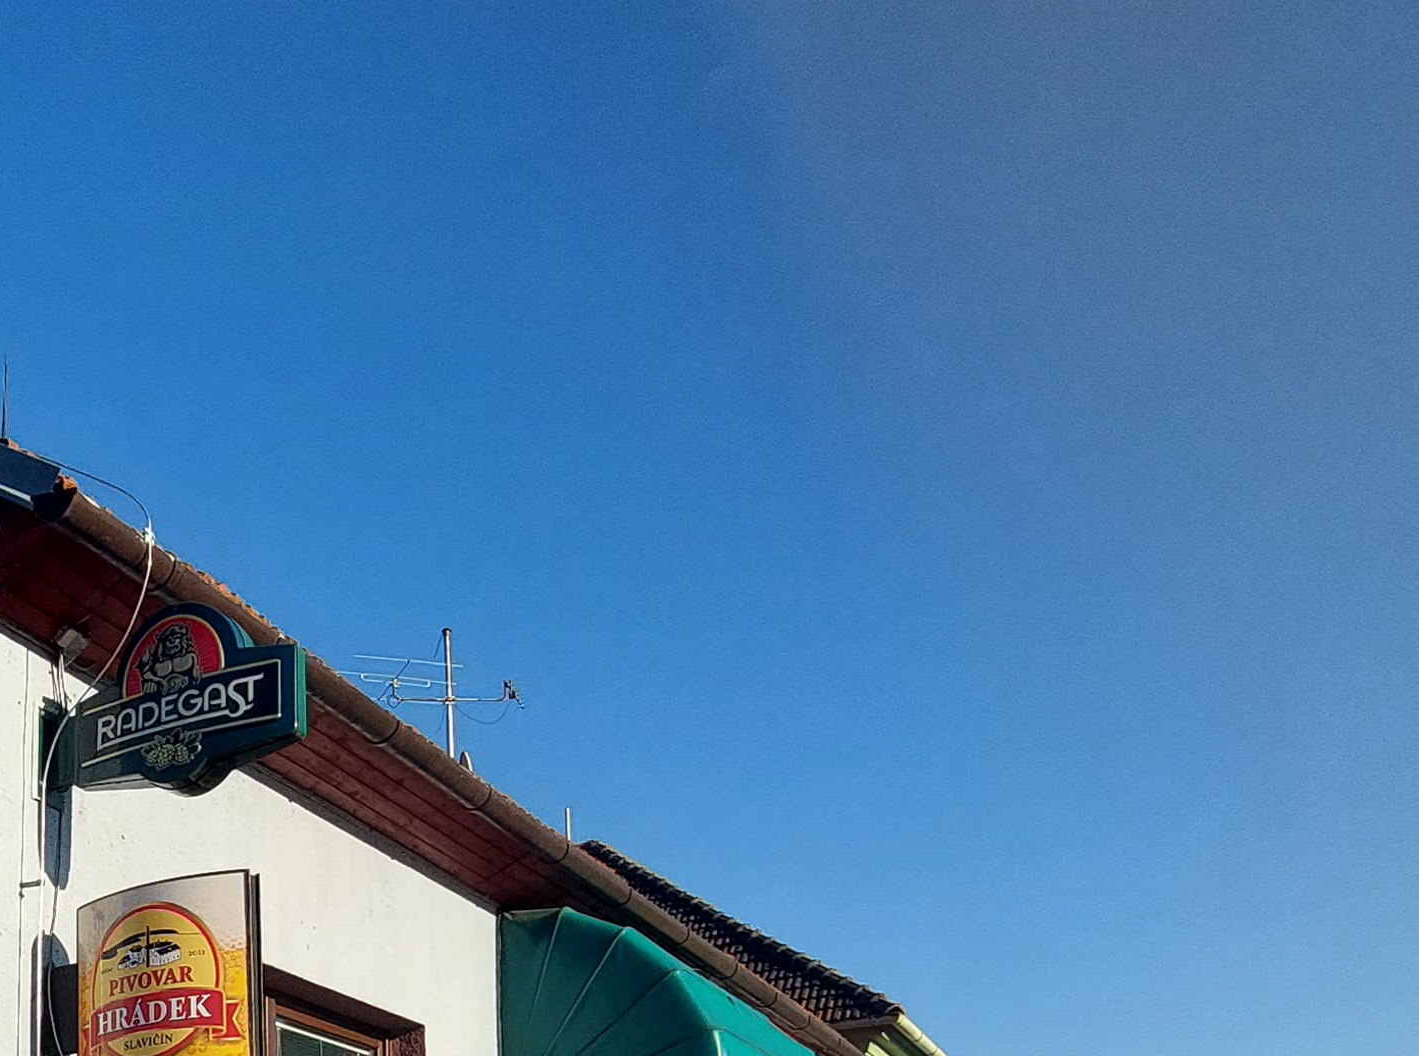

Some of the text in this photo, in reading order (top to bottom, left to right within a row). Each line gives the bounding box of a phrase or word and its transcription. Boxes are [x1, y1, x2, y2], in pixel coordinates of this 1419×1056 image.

[96, 672, 264, 752] RADEGAST
[109, 965, 194, 997] PIVOVAR
[97, 994, 212, 1036] HRÁDEK
